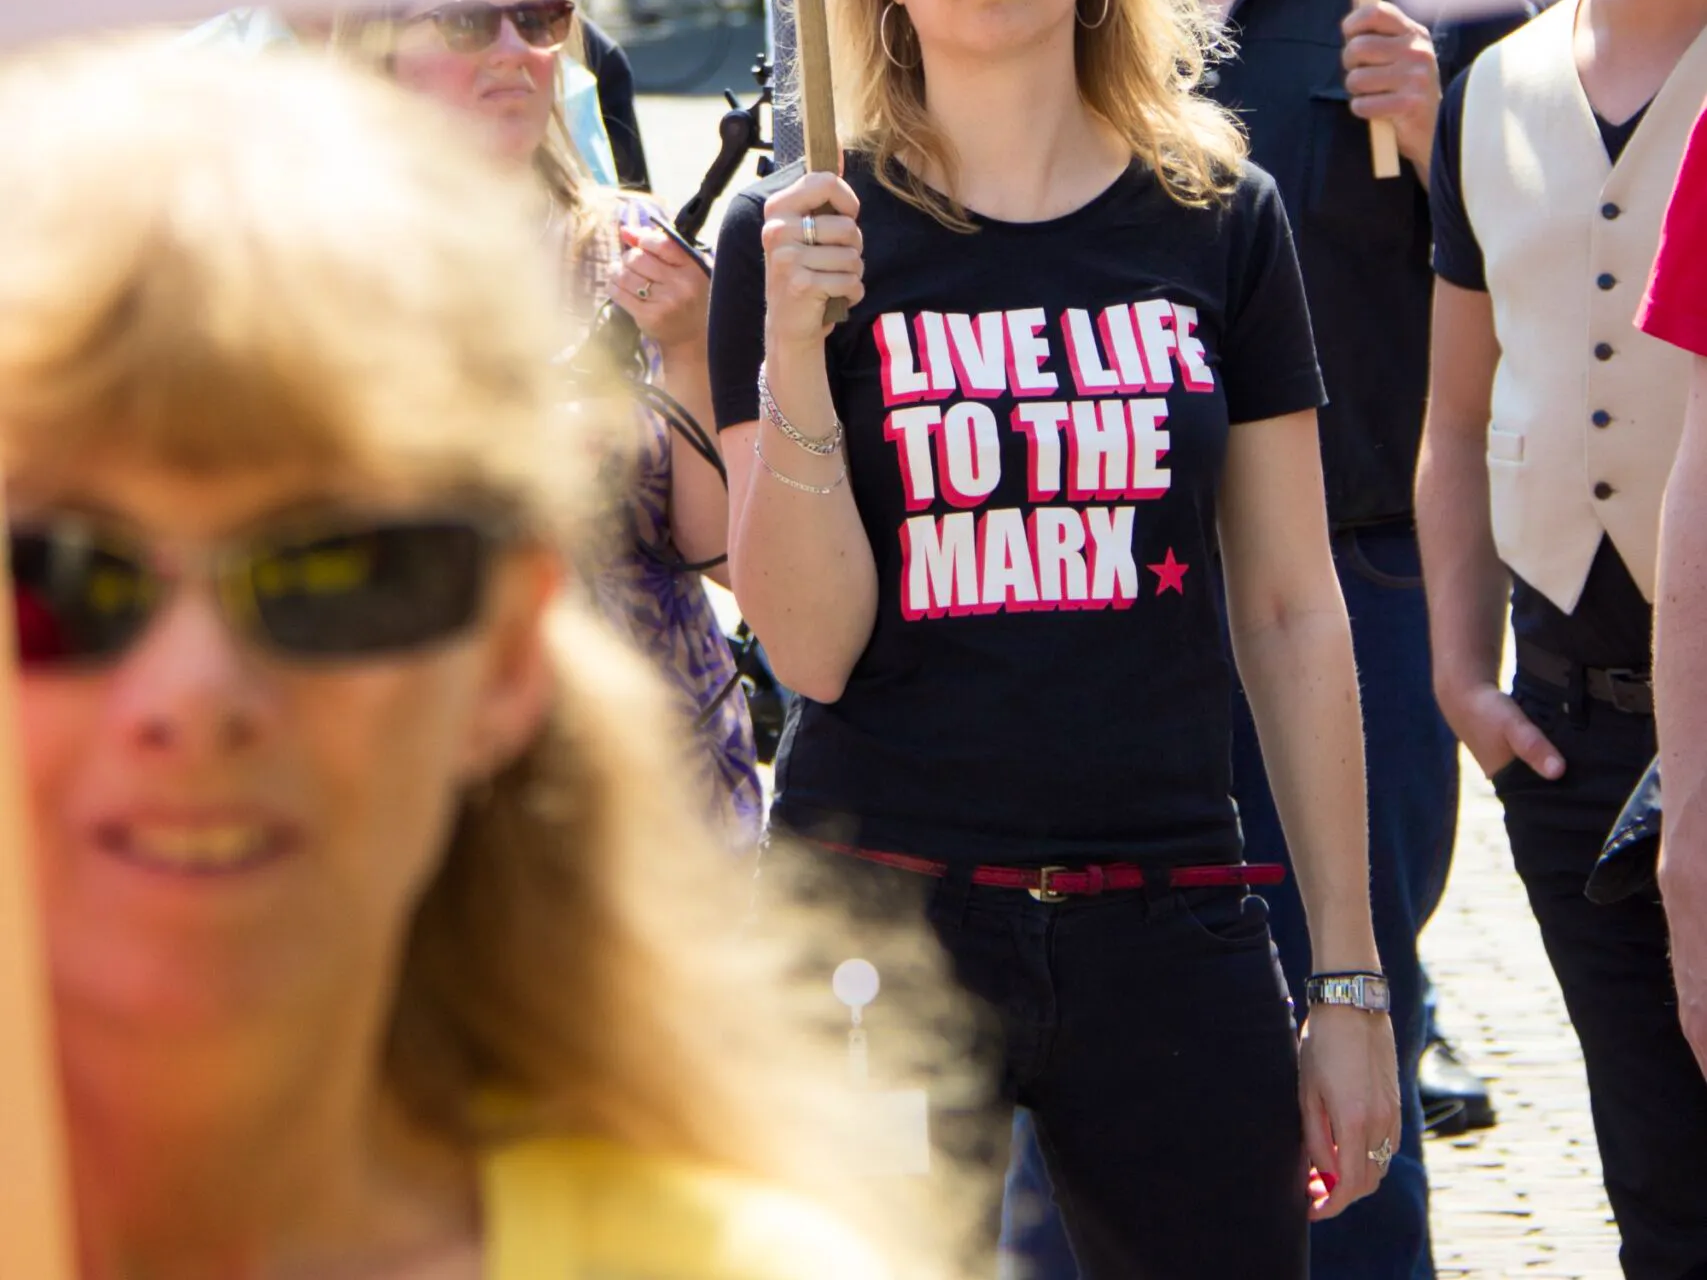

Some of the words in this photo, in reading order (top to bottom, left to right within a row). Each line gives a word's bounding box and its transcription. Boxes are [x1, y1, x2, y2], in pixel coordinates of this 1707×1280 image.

[873, 307, 1058, 407] LIVE
[1060, 299, 1215, 395] LIFE
[884, 401, 1001, 511] TO
[1010, 399, 1171, 503] THE
[899, 506, 1138, 621] MARX
